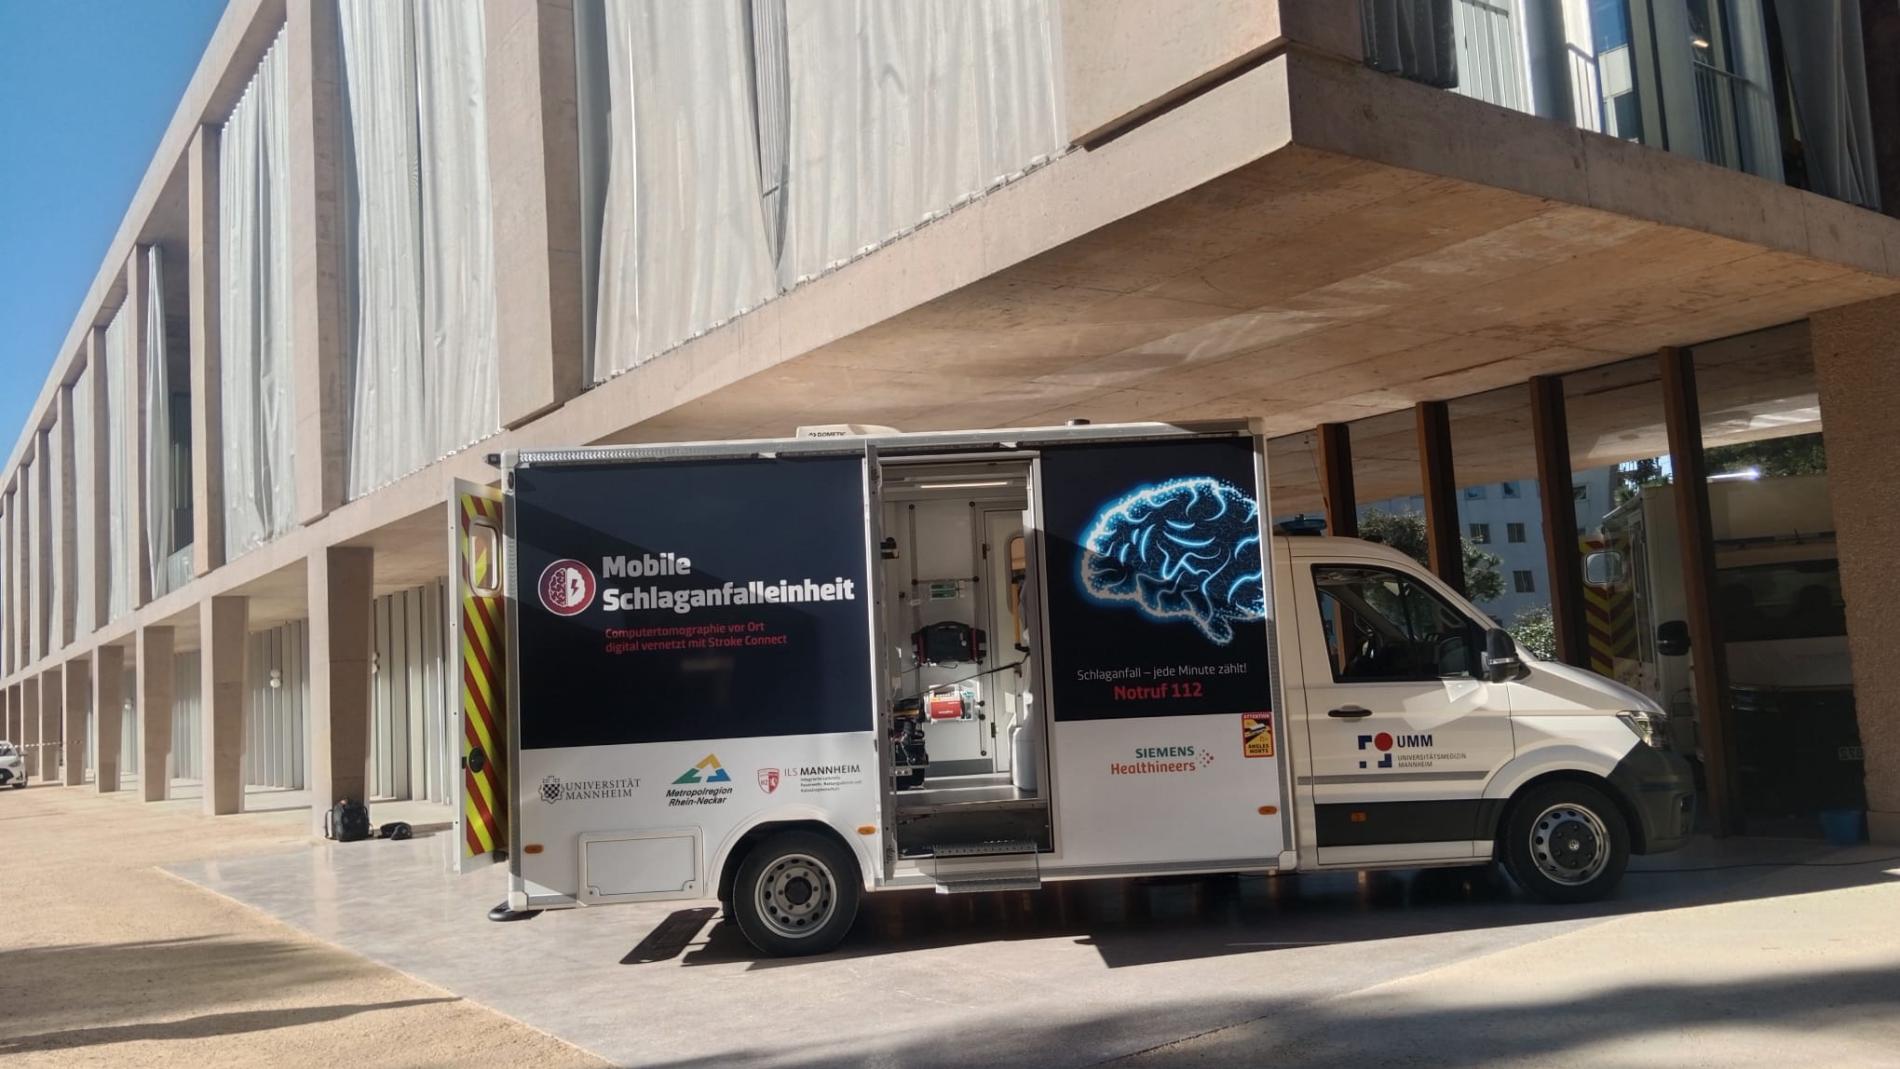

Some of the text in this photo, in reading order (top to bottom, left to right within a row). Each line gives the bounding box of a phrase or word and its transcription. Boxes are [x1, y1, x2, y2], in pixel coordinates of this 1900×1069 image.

[602, 552, 691, 579] Mobile
[603, 577, 855, 614] Schlaganfalleinheit
[605, 621, 764, 638] Computertomographie vor Ort
[605, 635, 787, 655] digital vernetzt mit Stroke Connect
[1077, 667, 1141, 682] Schlaganfall
[1153, 666, 1176, 680] jede
[1178, 664, 1216, 677] Minute
[1218, 662, 1248, 675] zählt!
[1113, 682, 1204, 700] Notruf 112
[1397, 735, 1433, 748] UMM
[1135, 745, 1195, 759] SIEMENS
[784, 764, 861, 777] ILS MANNHEIM
[1110, 760, 1196, 775] Healthineers
[565, 777, 641, 791] UNIVERSITÄT
[565, 789, 633, 801] MANNHEIM
[665, 786, 733, 799] Metropolregion
[668, 796, 728, 808] Rhein-Neckar
